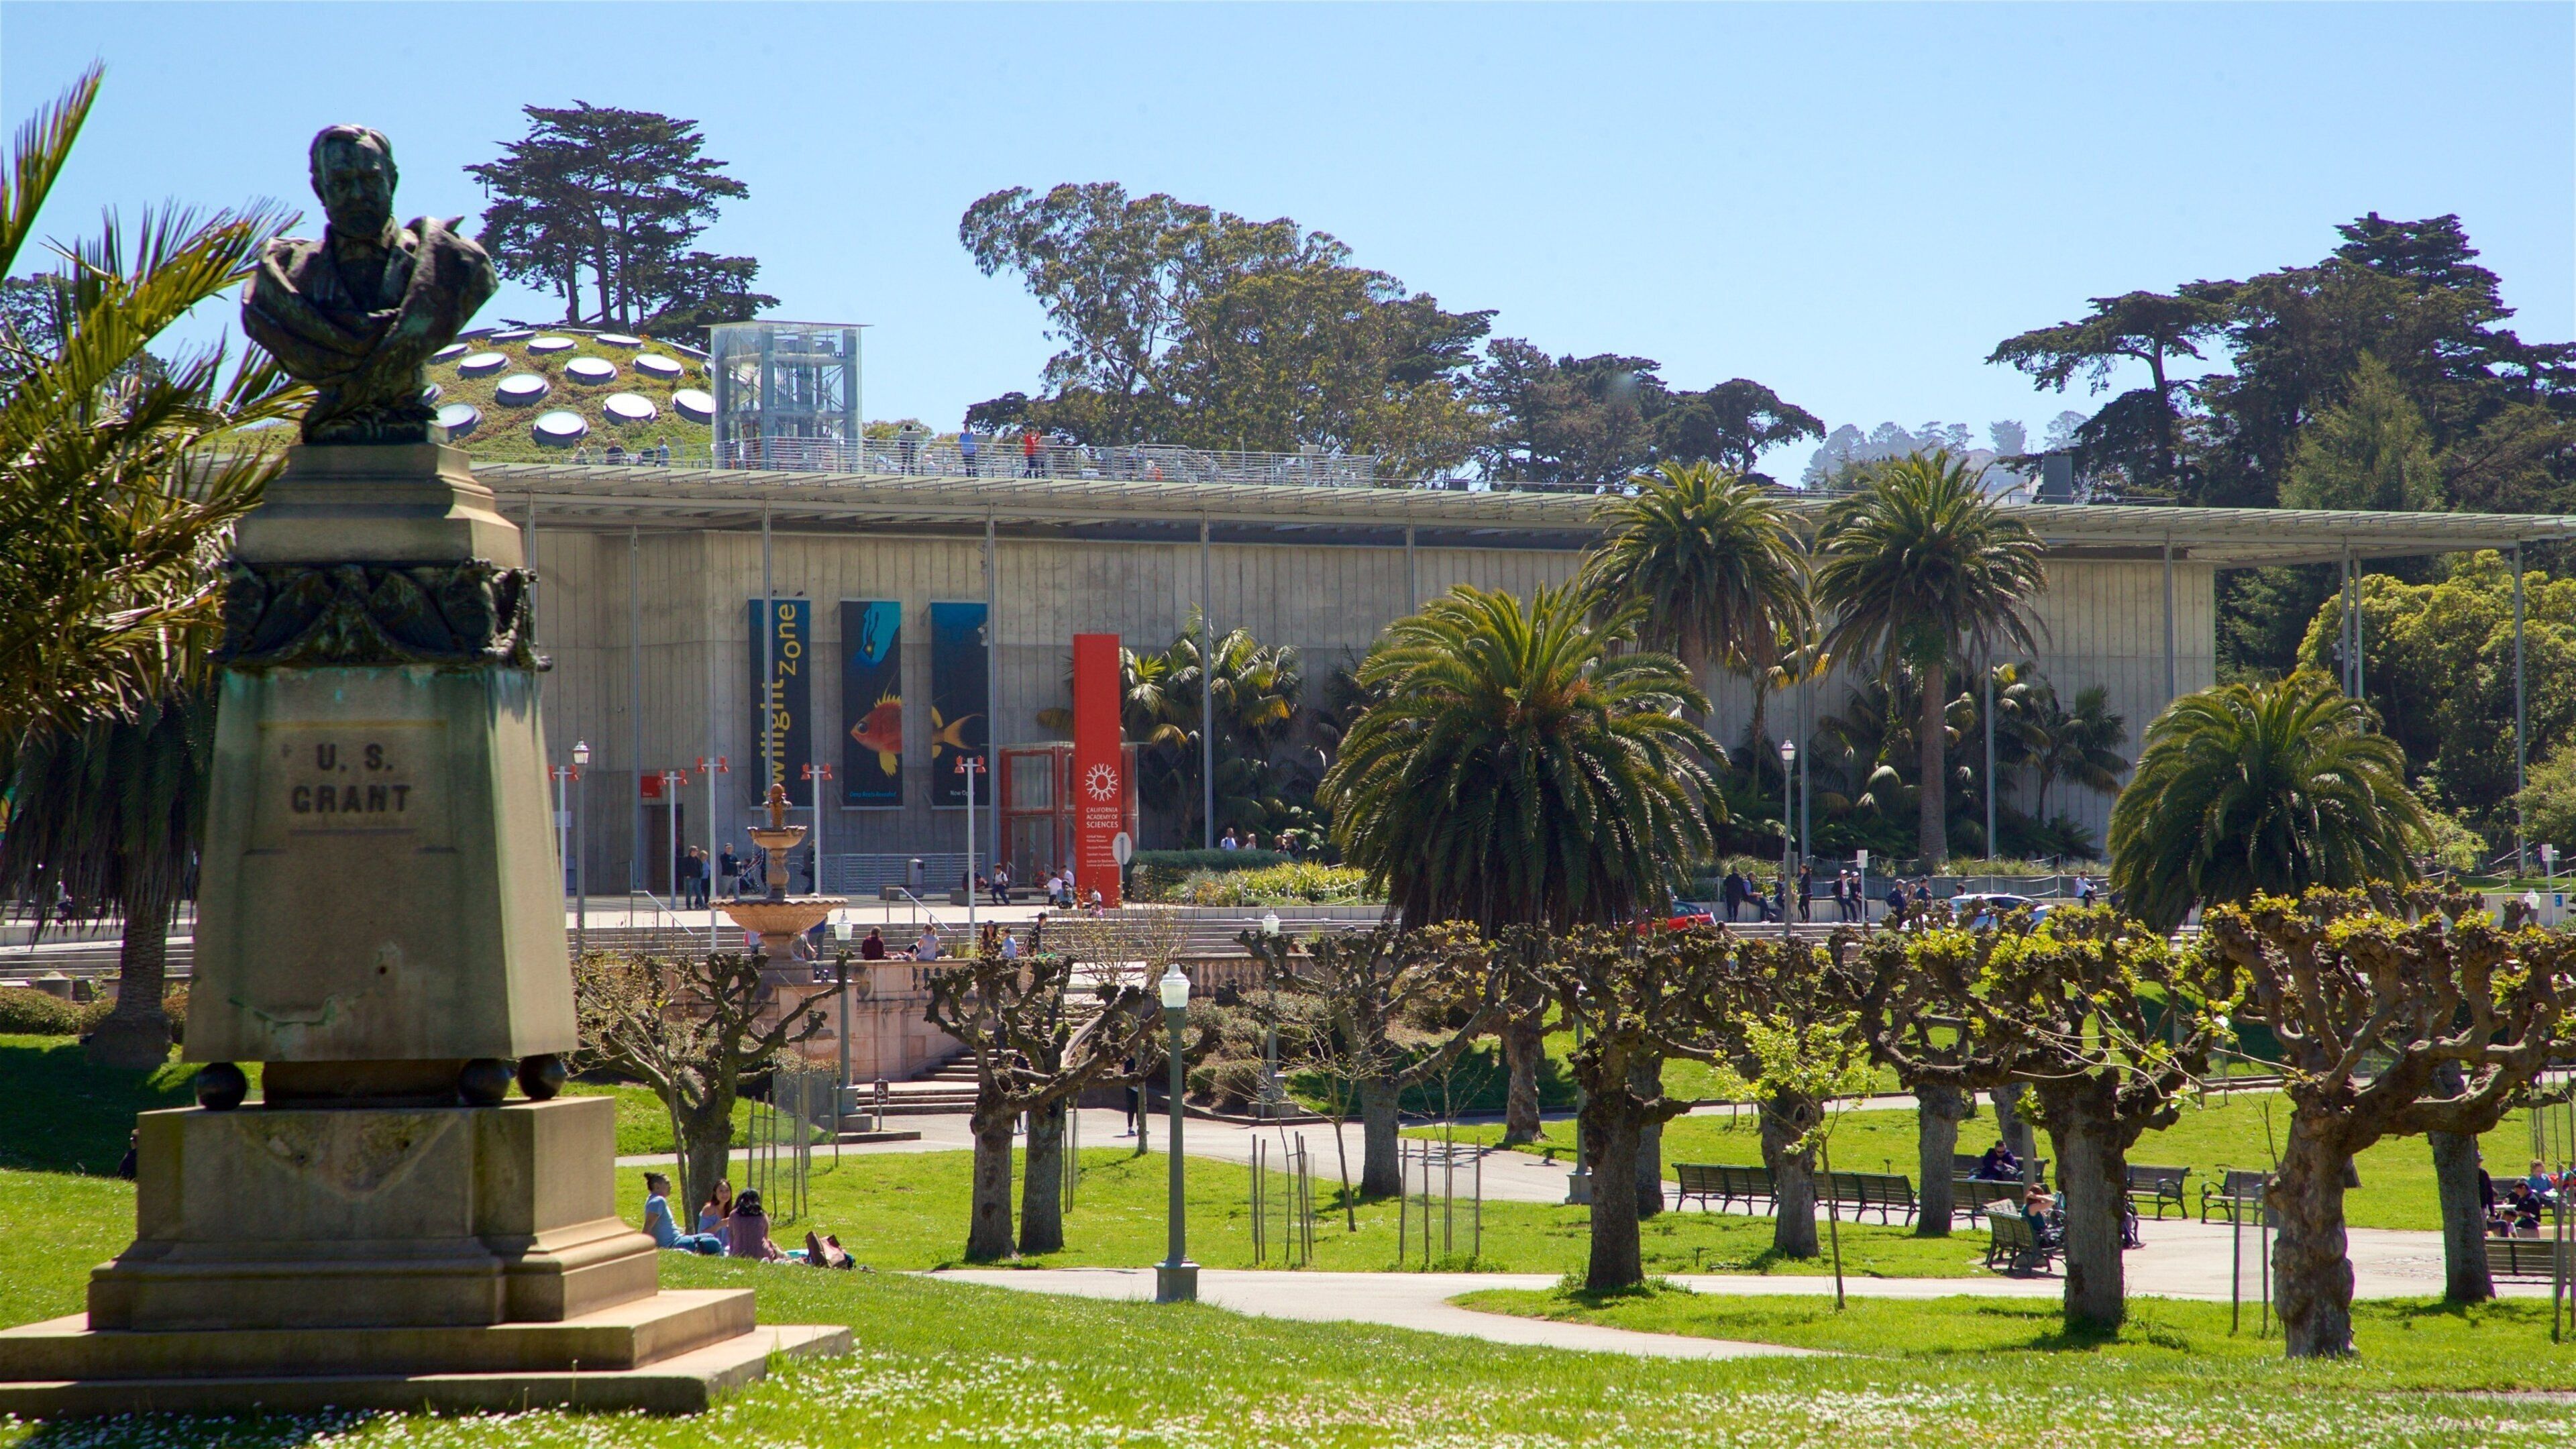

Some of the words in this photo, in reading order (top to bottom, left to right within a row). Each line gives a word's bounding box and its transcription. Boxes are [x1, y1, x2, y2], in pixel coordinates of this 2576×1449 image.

[760, 679, 790, 797] wilight
[779, 604, 801, 676] zone
[317, 743, 347, 771] U.
[364, 743, 393, 771] S.
[291, 785, 411, 813] GRANT
